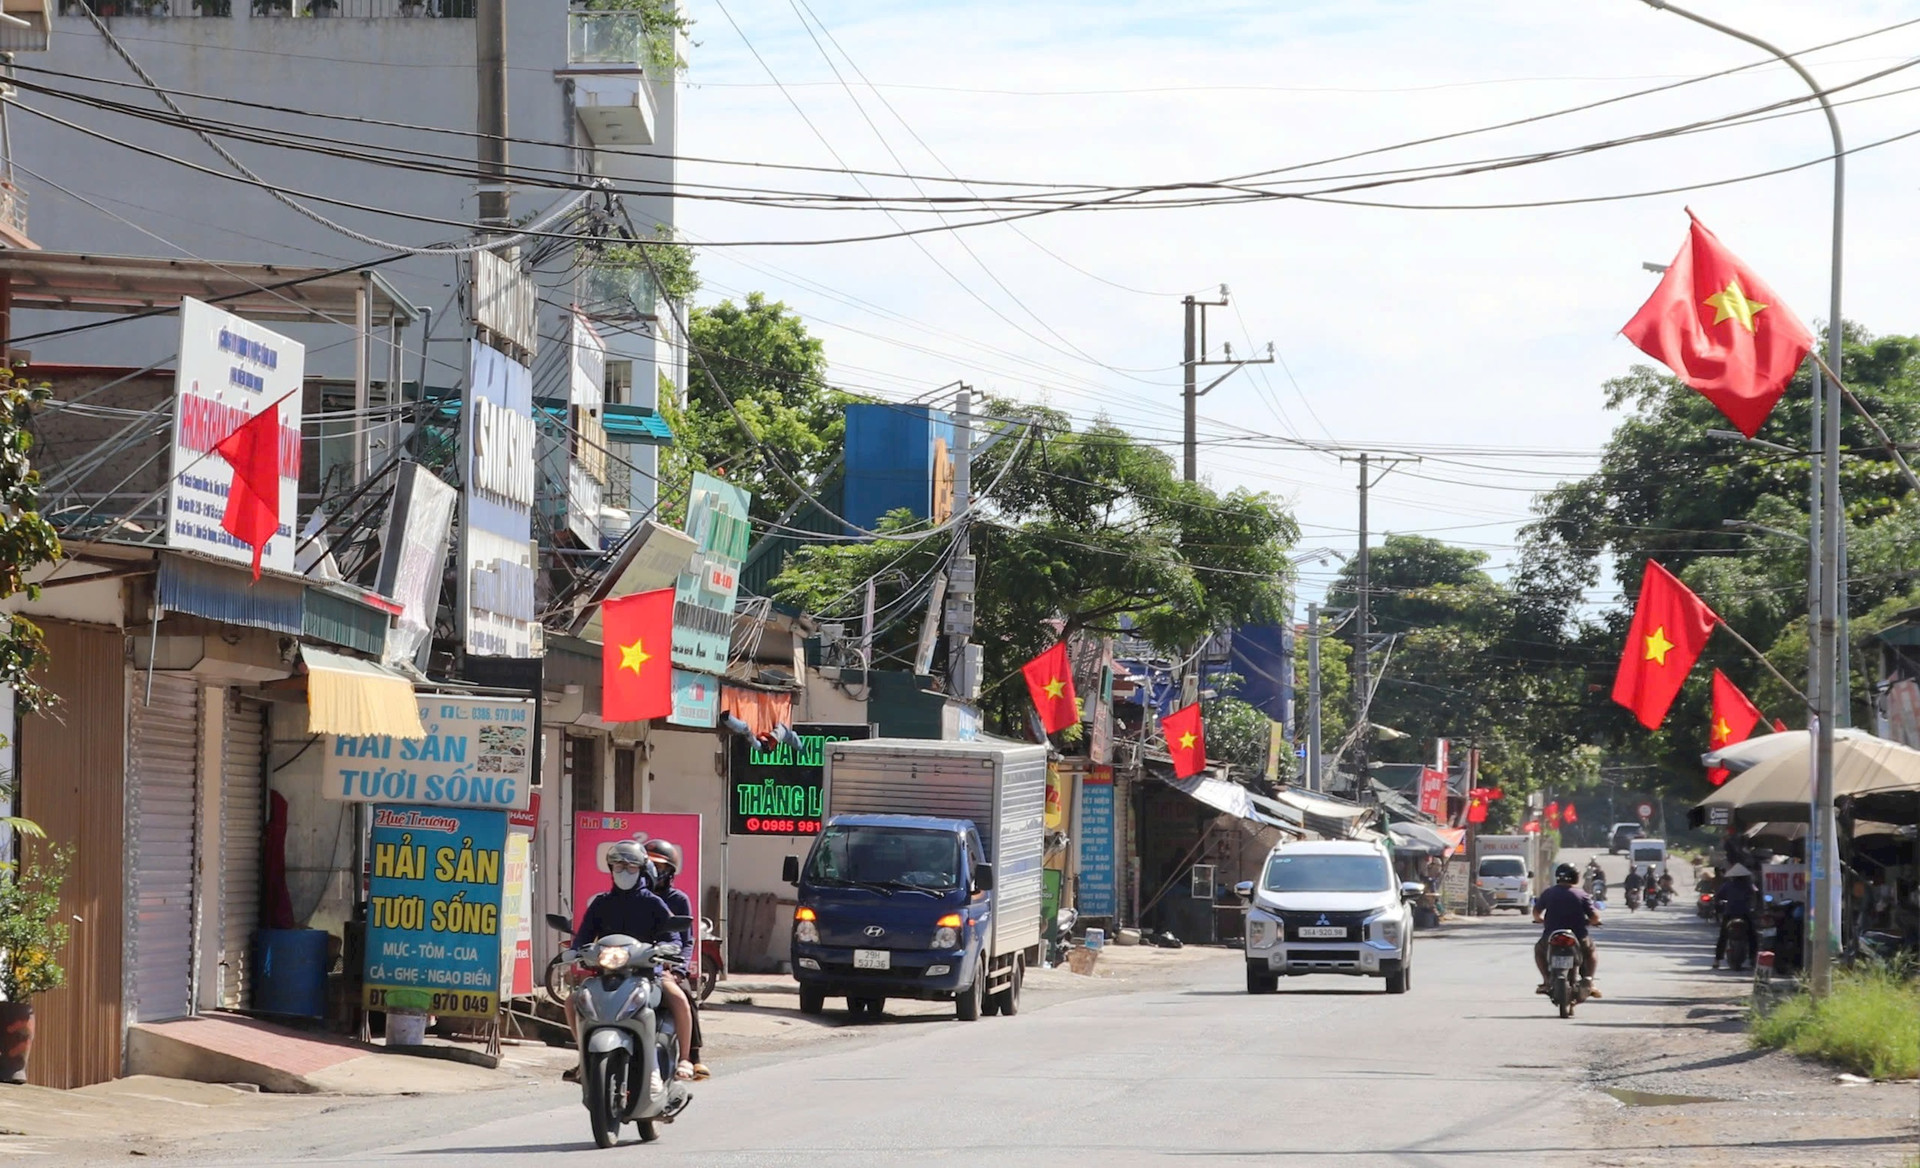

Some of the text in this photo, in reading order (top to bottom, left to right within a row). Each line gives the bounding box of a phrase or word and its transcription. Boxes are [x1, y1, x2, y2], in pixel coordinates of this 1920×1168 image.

[474, 395, 536, 508] SAMSUNG
[400, 724, 468, 763] SẢN
[339, 763, 516, 805] TƯƠI SỐNG
[737, 779, 824, 817] THĂNG L
[602, 817, 628, 830] Kids
[762, 820, 822, 832] 0985 981
[375, 833, 427, 880] HẢI
[435, 837, 499, 885] SẢN
[371, 894, 425, 930] TƯƠI
[431, 890, 497, 935] SỐNG
[383, 942, 478, 961] MỰC TÔM CUA
[864, 950, 881, 959] 29H
[369, 963, 385, 979] CÁ
[394, 967, 419, 985] GHẸ
[428, 970, 461, 984] NGAO
[858, 959, 886, 968] 537.36
[433, 993, 458, 1011] 970
[463, 995, 488, 1013] 049
